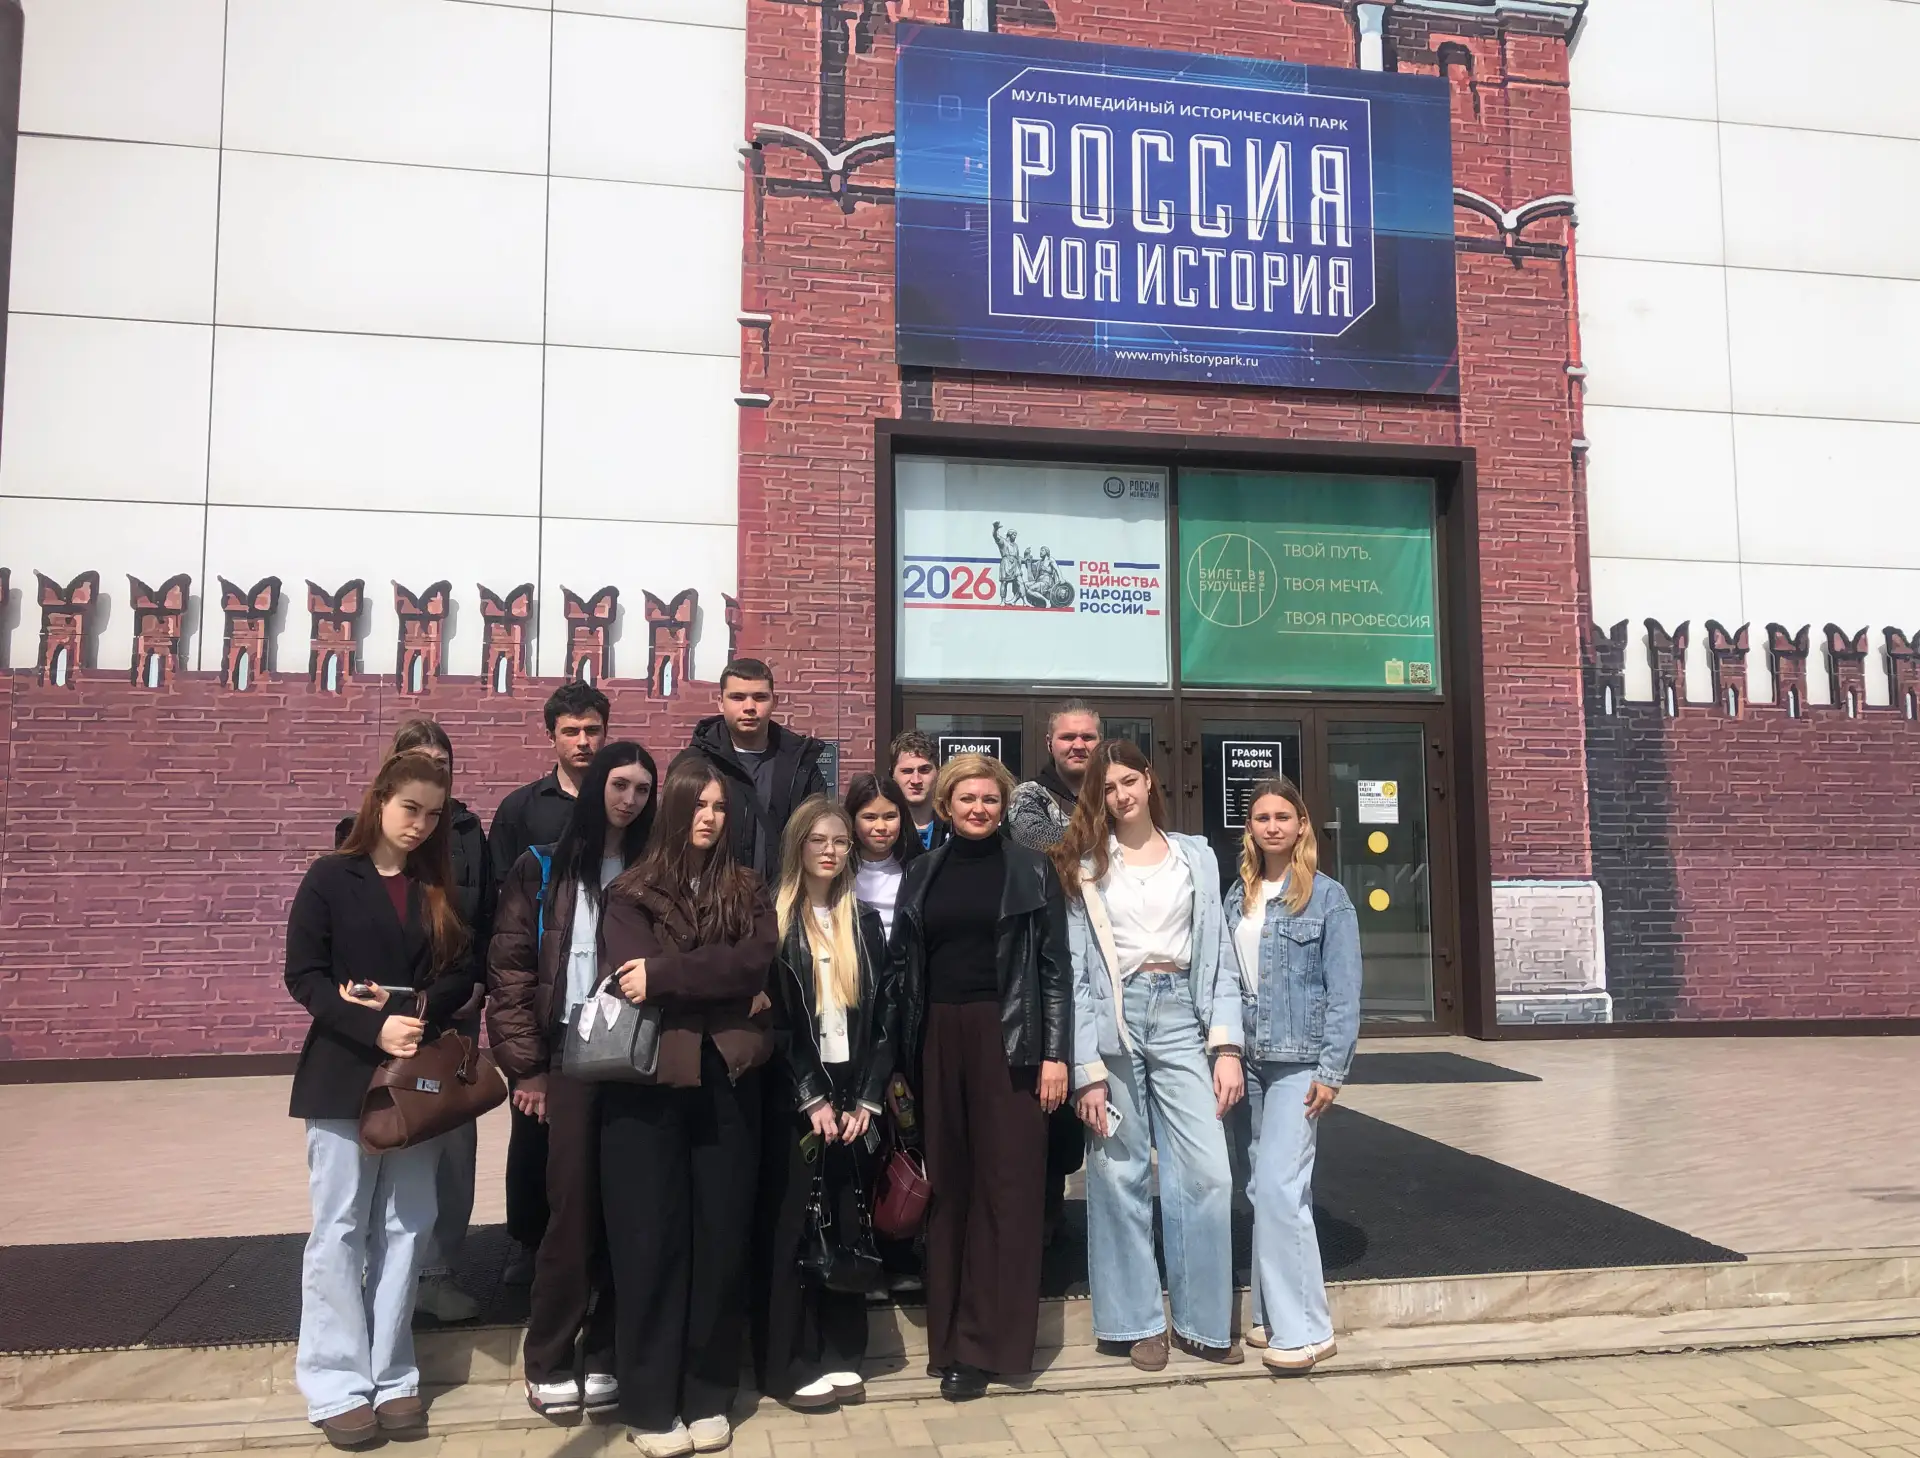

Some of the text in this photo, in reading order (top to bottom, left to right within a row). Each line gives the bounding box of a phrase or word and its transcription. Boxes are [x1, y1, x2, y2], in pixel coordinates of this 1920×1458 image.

[1011, 88, 1348, 131] МУЛЬТИМЕДИЙНЫЙ ИСТОРИЧЕСКИЙ ПАРК
[1012, 117, 1352, 247] РОССИЯ
[1013, 233, 1353, 317] МОЯ ИСТОРИЯ
[1115, 350, 1259, 368] www.myhistorypark.ru
[1130, 480, 1160, 492] РОССИЯ
[1283, 543, 1325, 558] ТВОЙ
[1080, 561, 1110, 574] ГОД
[1200, 568, 1256, 580] БИЛЕТ В
[903, 565, 996, 600] 2026
[1080, 574, 1160, 588] ЕДИНСТВА
[1200, 580, 1256, 592] БУДУЩЕЕ
[1283, 577, 1383, 595] ТВОЯ МЕЧТА,
[1080, 588, 1152, 603] НАРОДОВ
[1080, 602, 1143, 614] РОССИИ
[1284, 611, 1430, 629] ТВОЯ ПРОФЕССИЯ
[948, 744, 991, 753] ГРАФИК
[1231, 749, 1272, 757] ГРАФИК
[1231, 760, 1272, 768] РАБОТЫ
